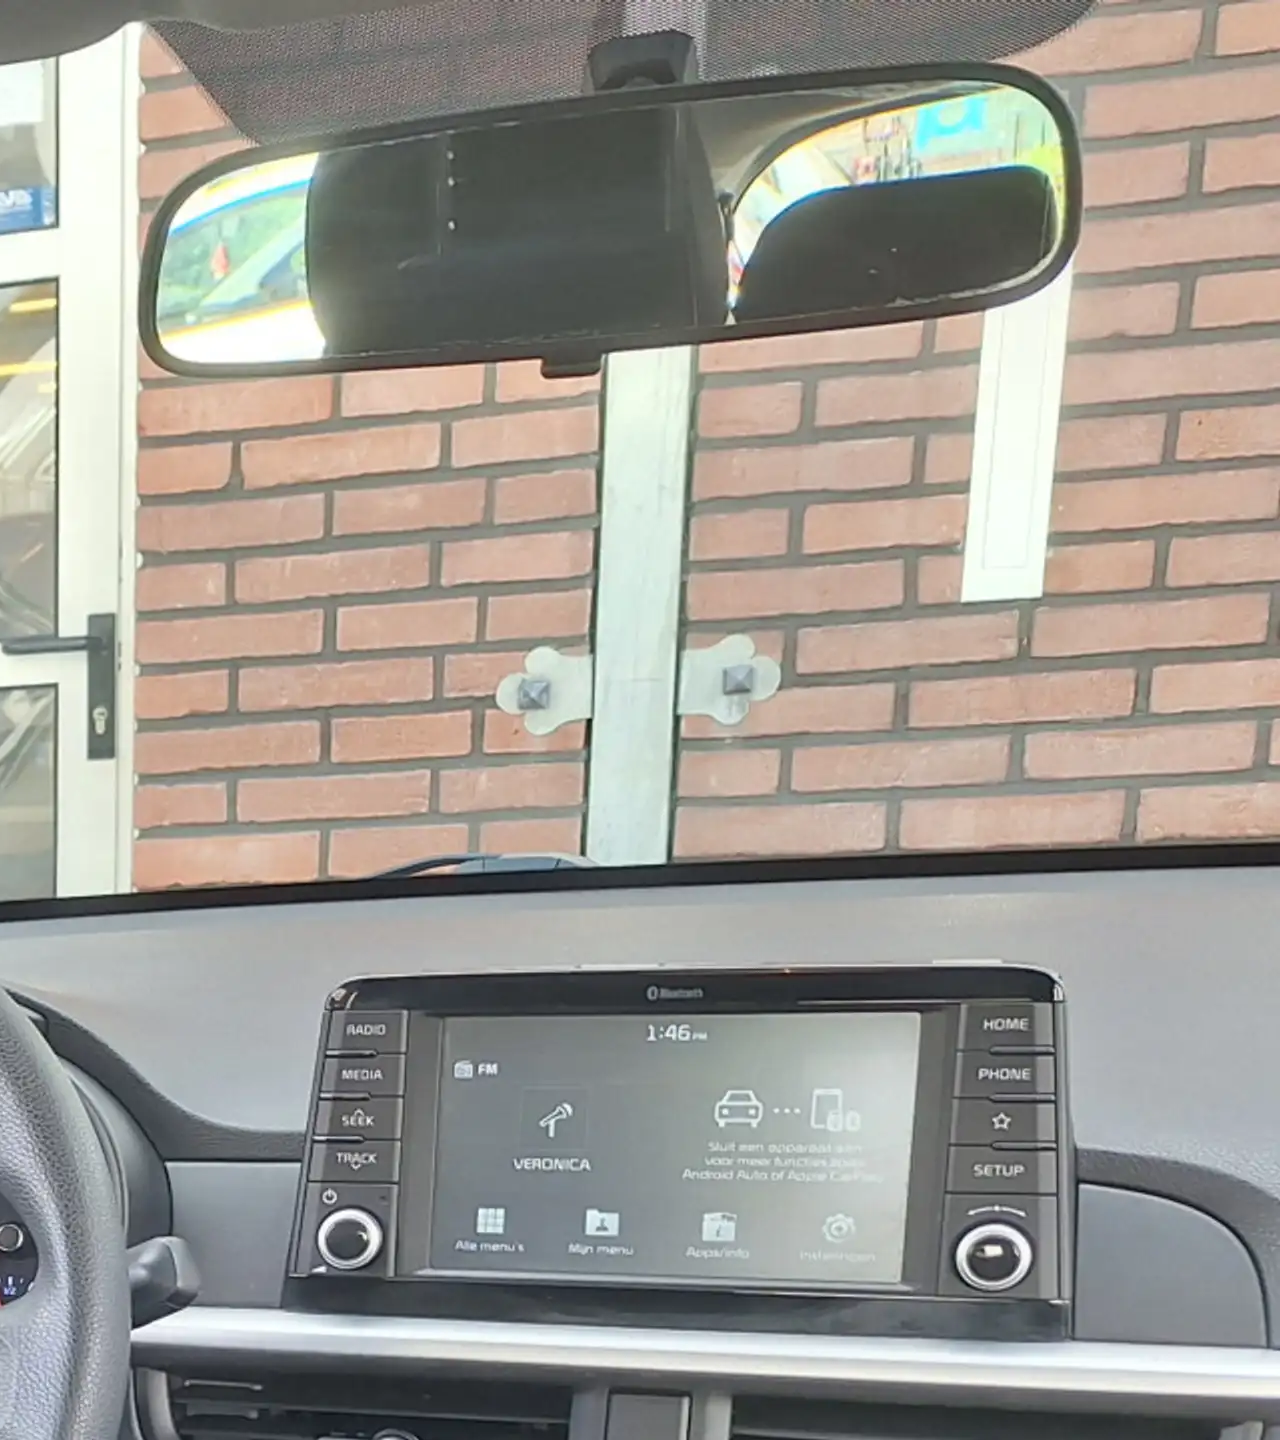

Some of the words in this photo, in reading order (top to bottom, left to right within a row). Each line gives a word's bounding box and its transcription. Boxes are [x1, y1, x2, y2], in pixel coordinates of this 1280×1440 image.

[346, 1023, 386, 1036] RADIO
[983, 1018, 1029, 1031] HOME
[646, 1023, 691, 1041] 1:46
[341, 1068, 383, 1081] MEDIA
[477, 1062, 499, 1076] FM
[977, 1068, 1031, 1081] PHONE
[341, 1115, 375, 1127] SEEK
[336, 1152, 377, 1164] TRACK
[512, 1157, 592, 1172] VERONICA
[681, 1168, 734, 1181] Android
[736, 1169, 768, 1181] Auto
[770, 1169, 785, 1181] of
[973, 1164, 1025, 1178] SETUP
[454, 1240, 477, 1251] Alle
[596, 1244, 635, 1256] menu
